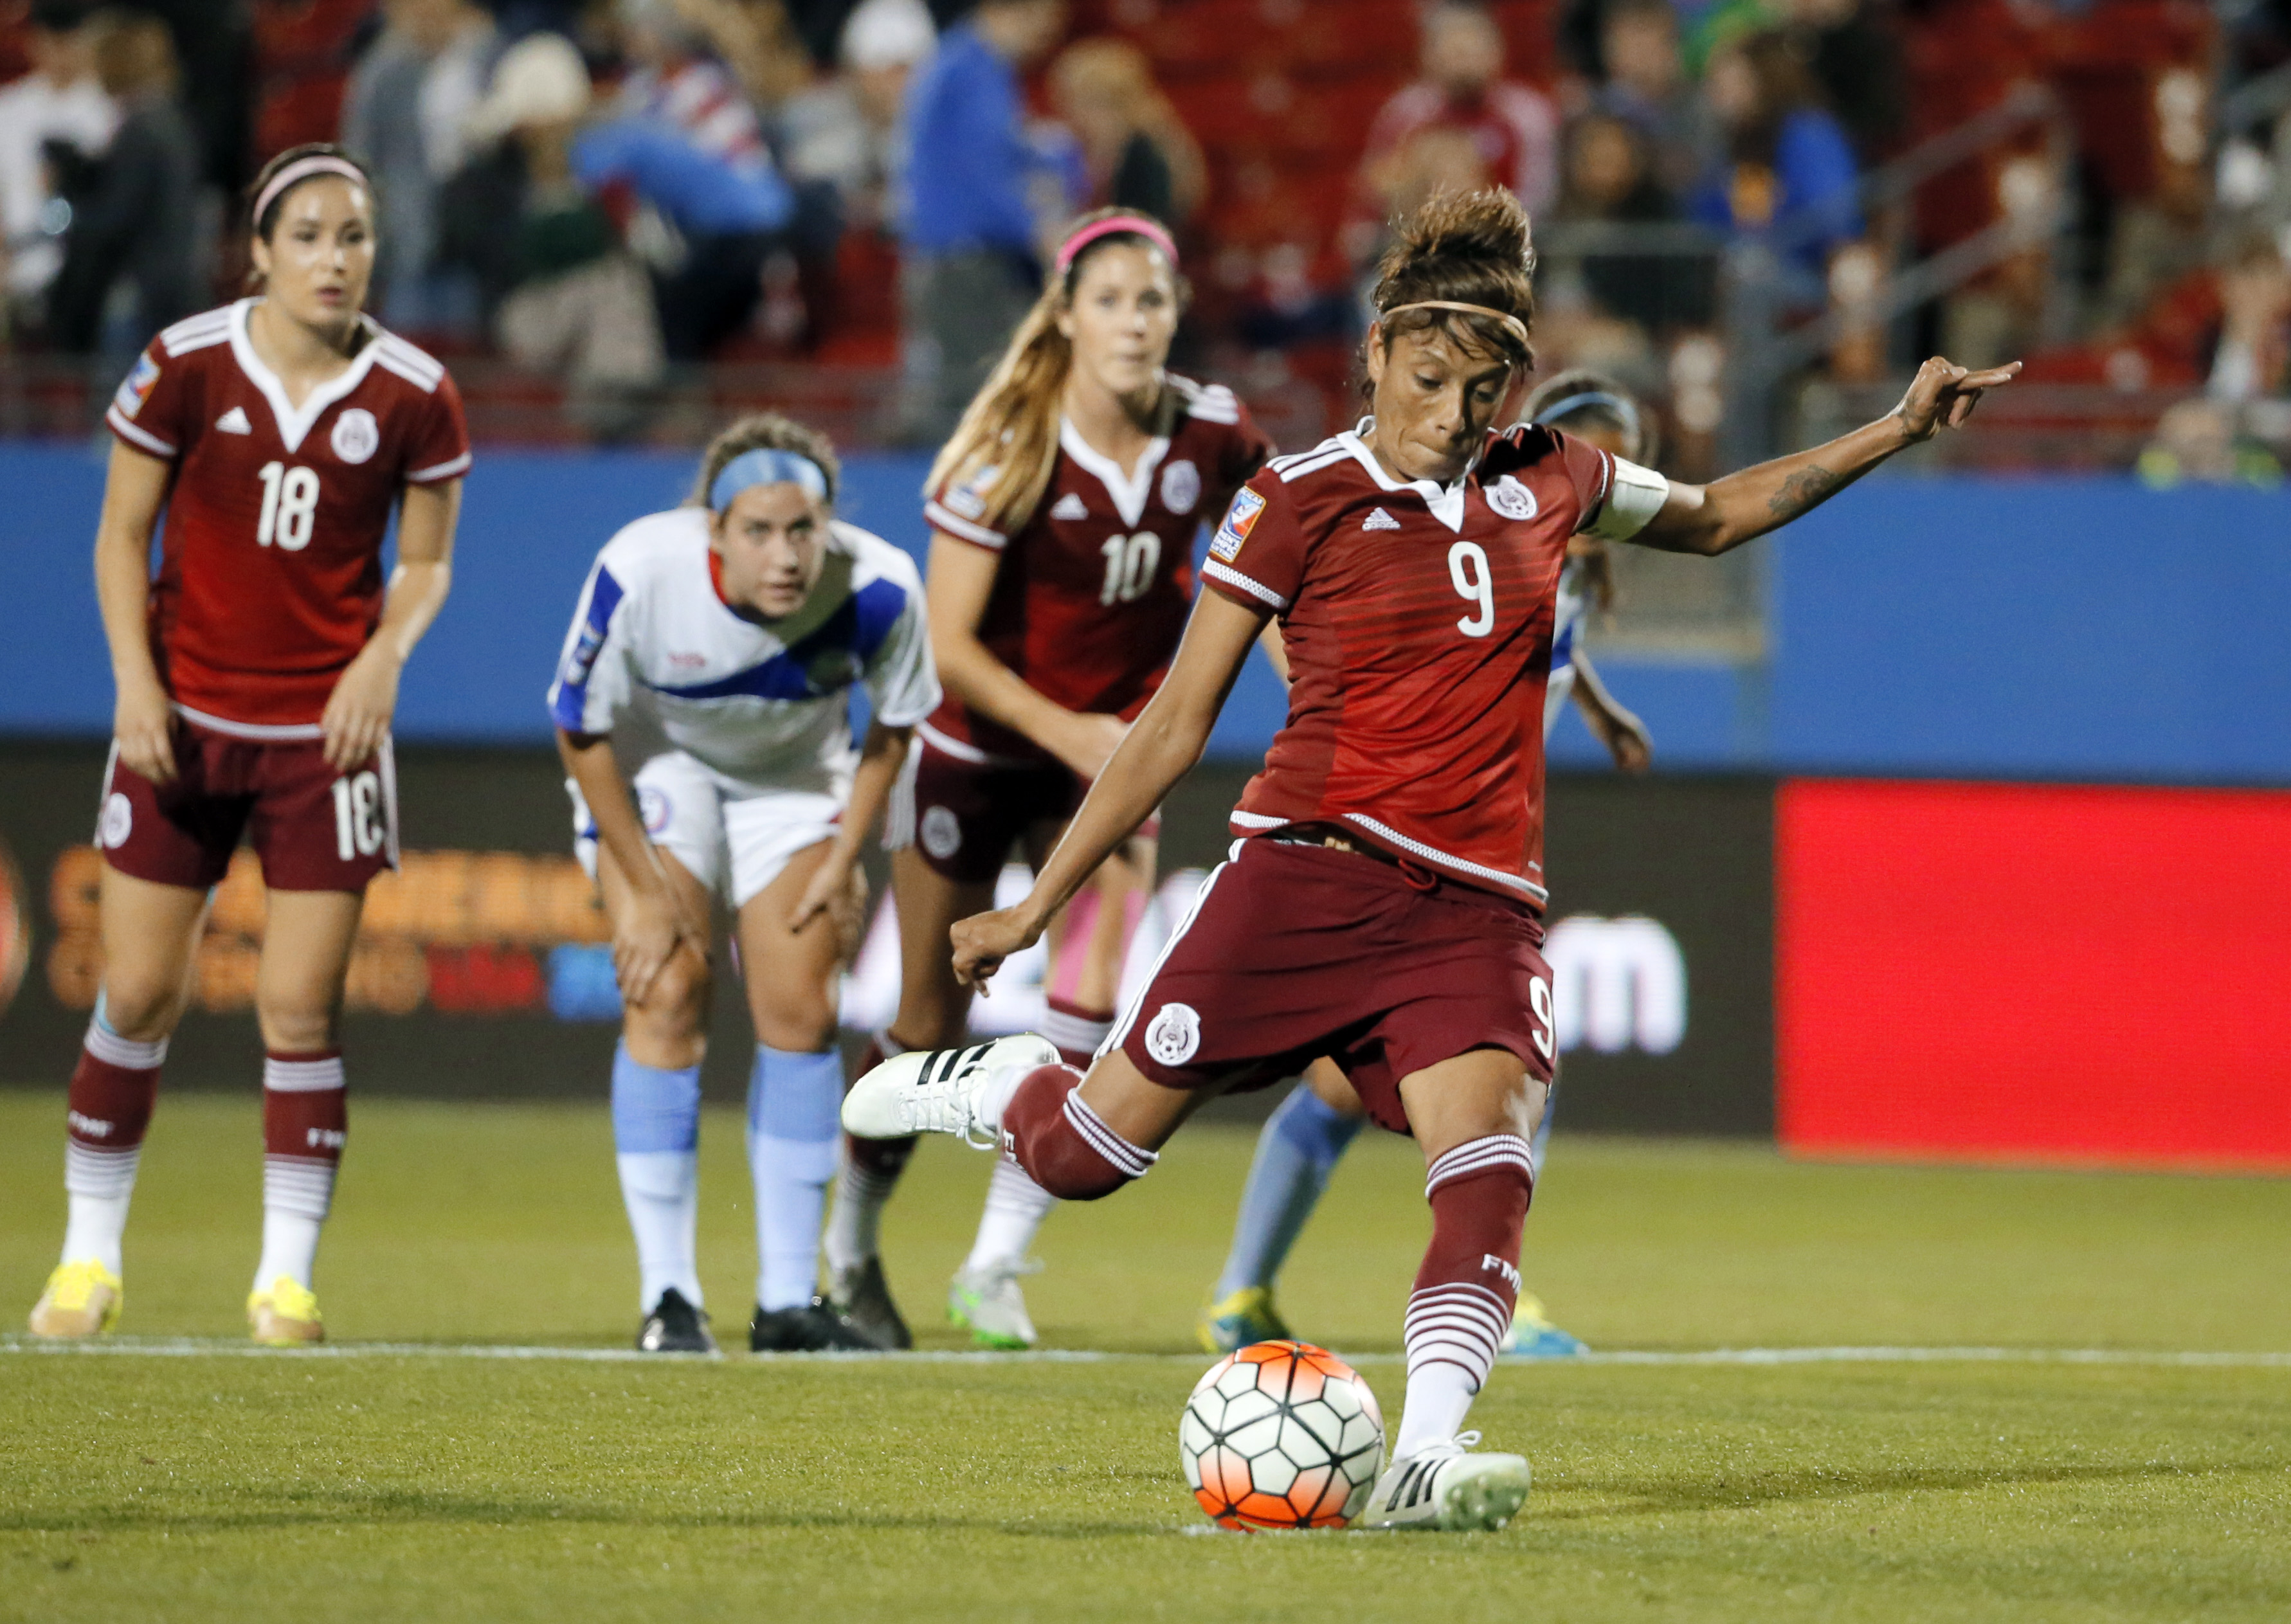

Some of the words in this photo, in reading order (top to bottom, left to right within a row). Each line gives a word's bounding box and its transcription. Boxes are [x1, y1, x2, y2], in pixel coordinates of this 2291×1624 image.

[257, 461, 320, 551] 18
[1101, 530, 1161, 606] 10
[1447, 541, 1494, 637] 9
[331, 771, 384, 861] 18
[1529, 976, 1553, 1059] 9
